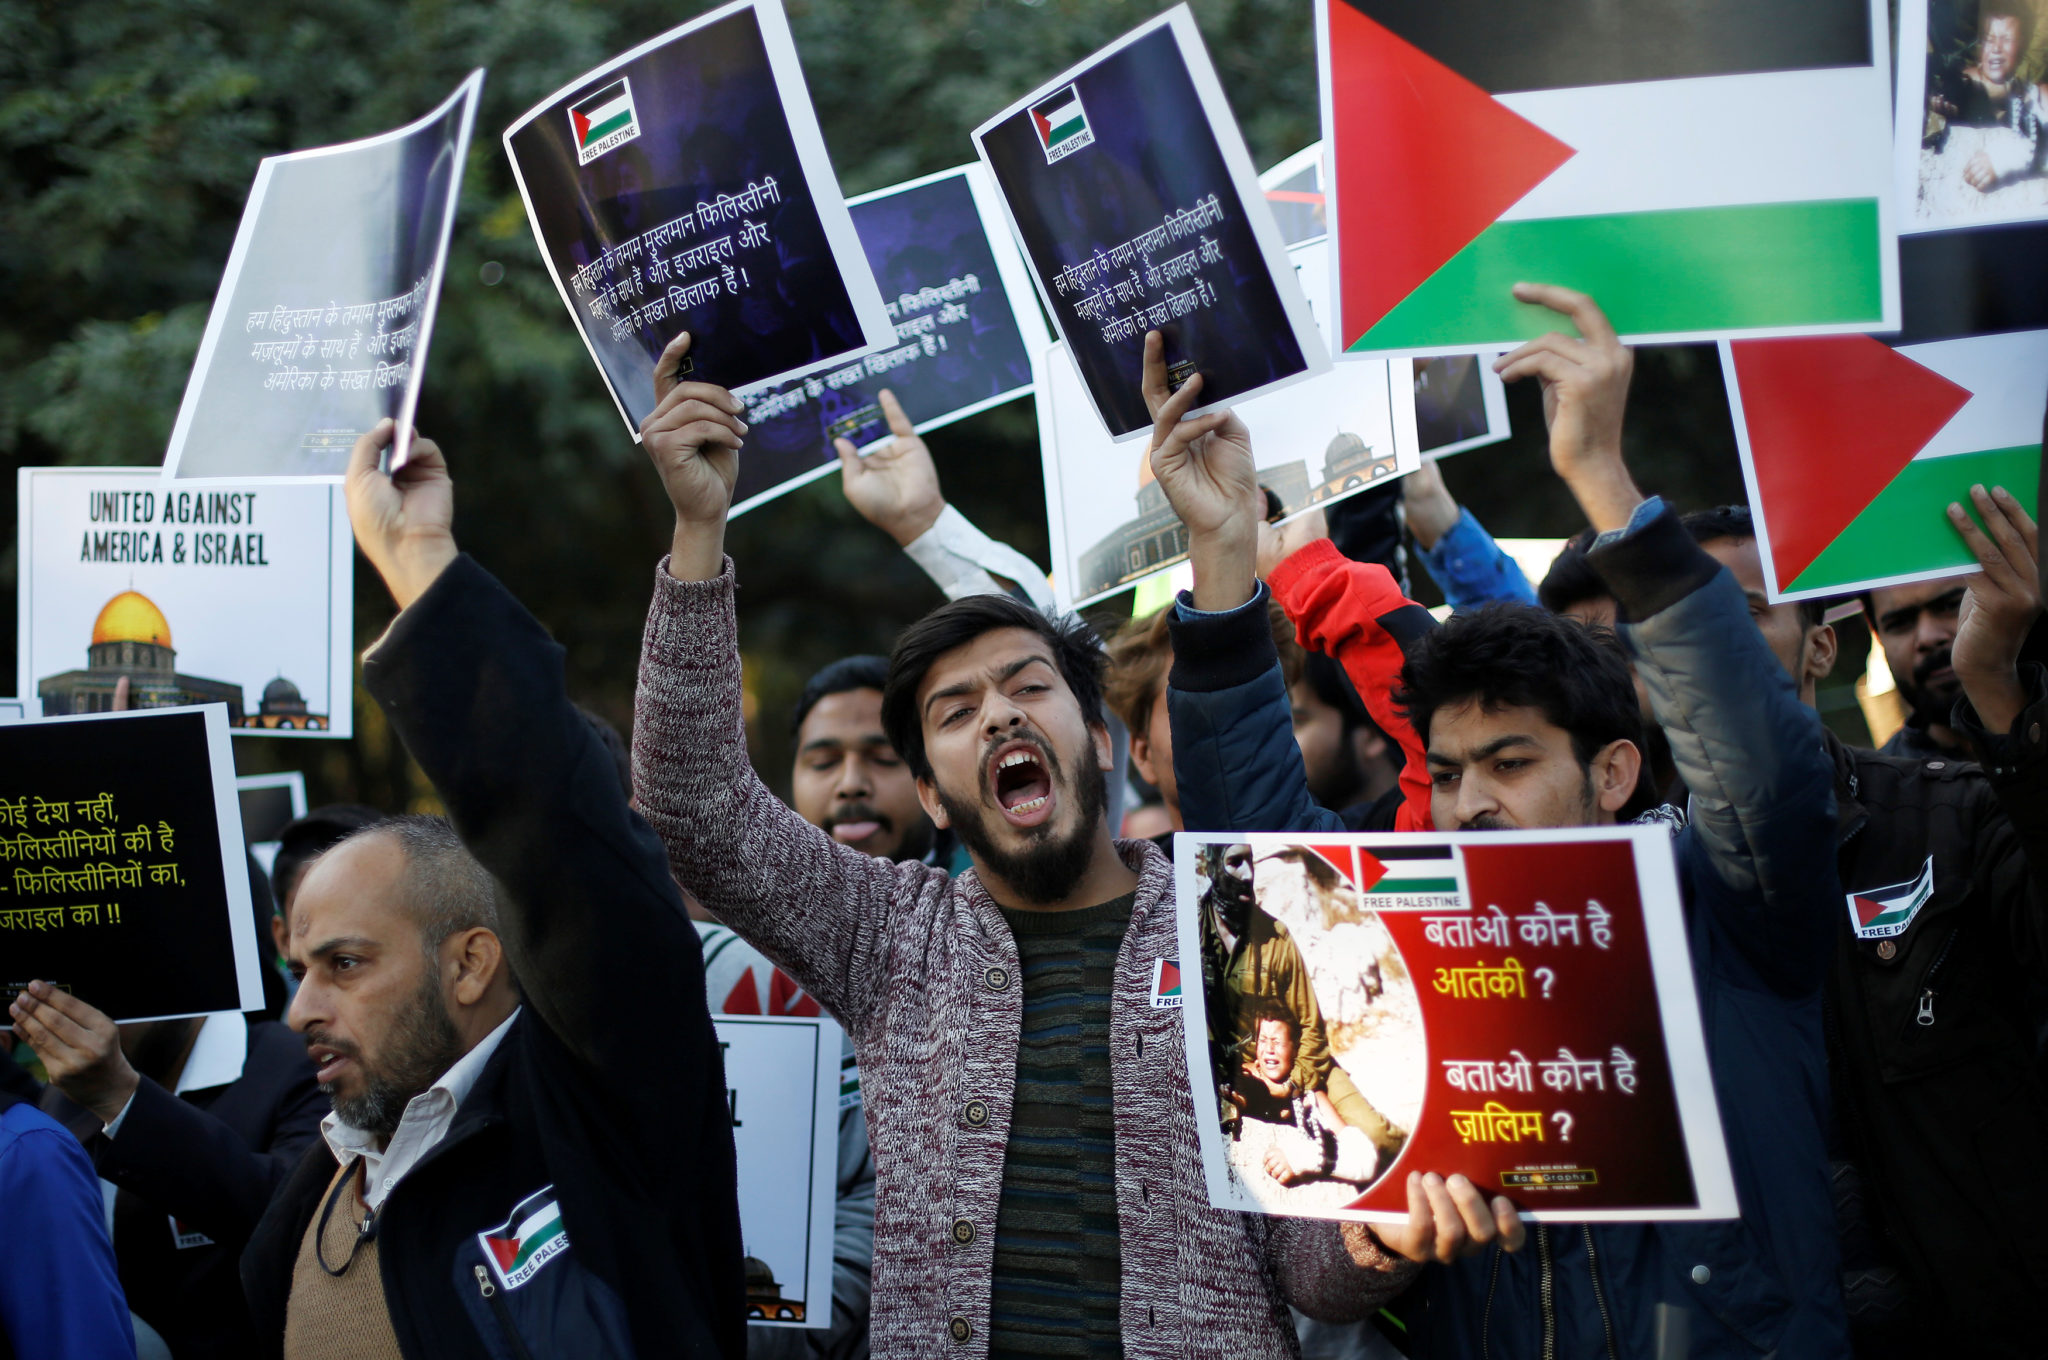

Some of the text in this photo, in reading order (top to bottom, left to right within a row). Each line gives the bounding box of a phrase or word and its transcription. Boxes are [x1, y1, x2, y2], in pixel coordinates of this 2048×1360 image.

[582, 126, 636, 163] FREE PALESTINE
[1048, 131, 1091, 161] FREE PALESTINE
[570, 176, 781, 297] हम हिंदुस्तान के तमाम मुस्लमान फिलिस्तीनी
[1052, 193, 1225, 297] हम हिंदुस्तान के तमाम मुस्लमान फिलिस्तीनी
[606, 282, 620, 306] के
[617, 276, 635, 303] साथ
[631, 265, 645, 295] हैं
[648, 257, 673, 285] और
[672, 235, 735, 277] इजराइल
[738, 219, 772, 249] और
[1073, 235, 1224, 321] मज़लूमों के साथ हैं और इजराइल और
[630, 305, 643, 331] के
[641, 296, 669, 326] सख्त
[668, 276, 720, 315] खिलाफ
[721, 264, 738, 295] हैं
[740, 267, 751, 288] !
[1101, 277, 1217, 345] अमेरिका के सख्त खिलाफ हैं !
[246, 311, 270, 333] हम
[268, 304, 325, 335] हिंदुस्तान
[325, 300, 343, 328] के
[341, 303, 377, 325] तमाम
[251, 334, 303, 365] मज़लूमों
[302, 333, 320, 359] के
[320, 337, 348, 359] साथ
[348, 329, 363, 360] हैं
[367, 326, 390, 355] और
[263, 365, 320, 391] अमेरिका
[319, 364, 339, 391] के
[339, 369, 374, 391] सख्त
[89, 491, 257, 525] UNITED AGAINST
[80, 531, 270, 566] AMERICA & ISRAEL
[32, 796, 70, 825] देश
[74, 792, 119, 823] नहीं,
[121, 824, 152, 853] की
[156, 820, 175, 853] है
[12, 859, 143, 896] फिलिस्तीनियों
[147, 863, 187, 887] का,
[69, 904, 100, 926] का
[107, 903, 121, 924] !!
[1363, 895, 1462, 908] FREE PALESTINE
[1420, 899, 1612, 949] बताओ कौन है
[1861, 926, 1892, 938] FREE
[1432, 957, 1556, 999] आतंकी ?
[1441, 1045, 1638, 1094] बताओ कौन है
[1449, 1101, 1575, 1145] ज़ालिम ?
[506, 1260, 536, 1287] FREE
